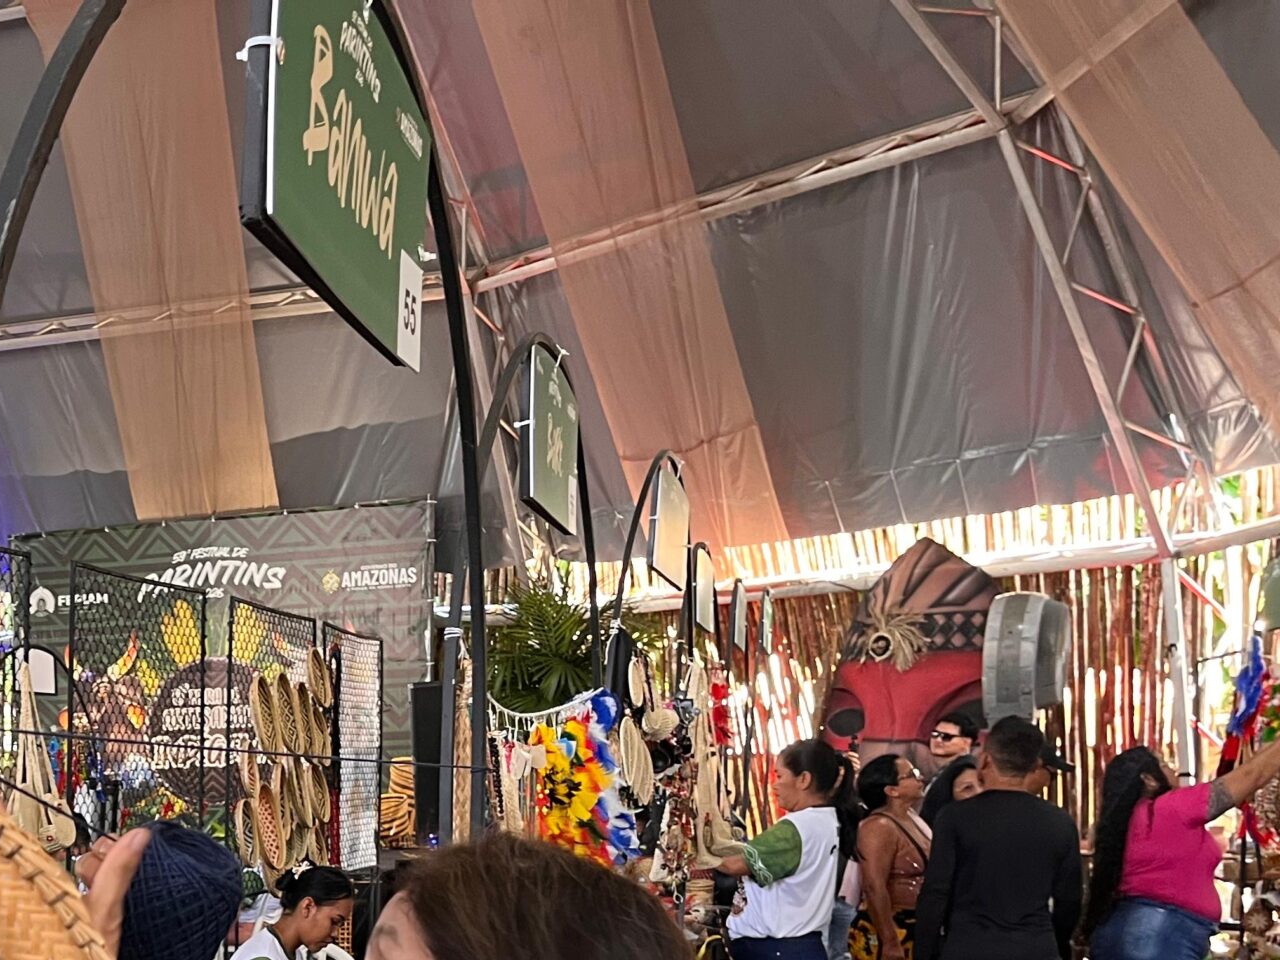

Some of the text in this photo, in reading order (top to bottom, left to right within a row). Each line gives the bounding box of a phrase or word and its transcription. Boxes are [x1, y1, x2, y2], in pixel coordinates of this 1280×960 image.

[403, 288, 417, 336] 55
[189, 546, 231, 561] FESTIVAL
[231, 546, 250, 558] DE
[136, 560, 288, 603] PARINTINS
[341, 567, 418, 589] AMAZONAS
